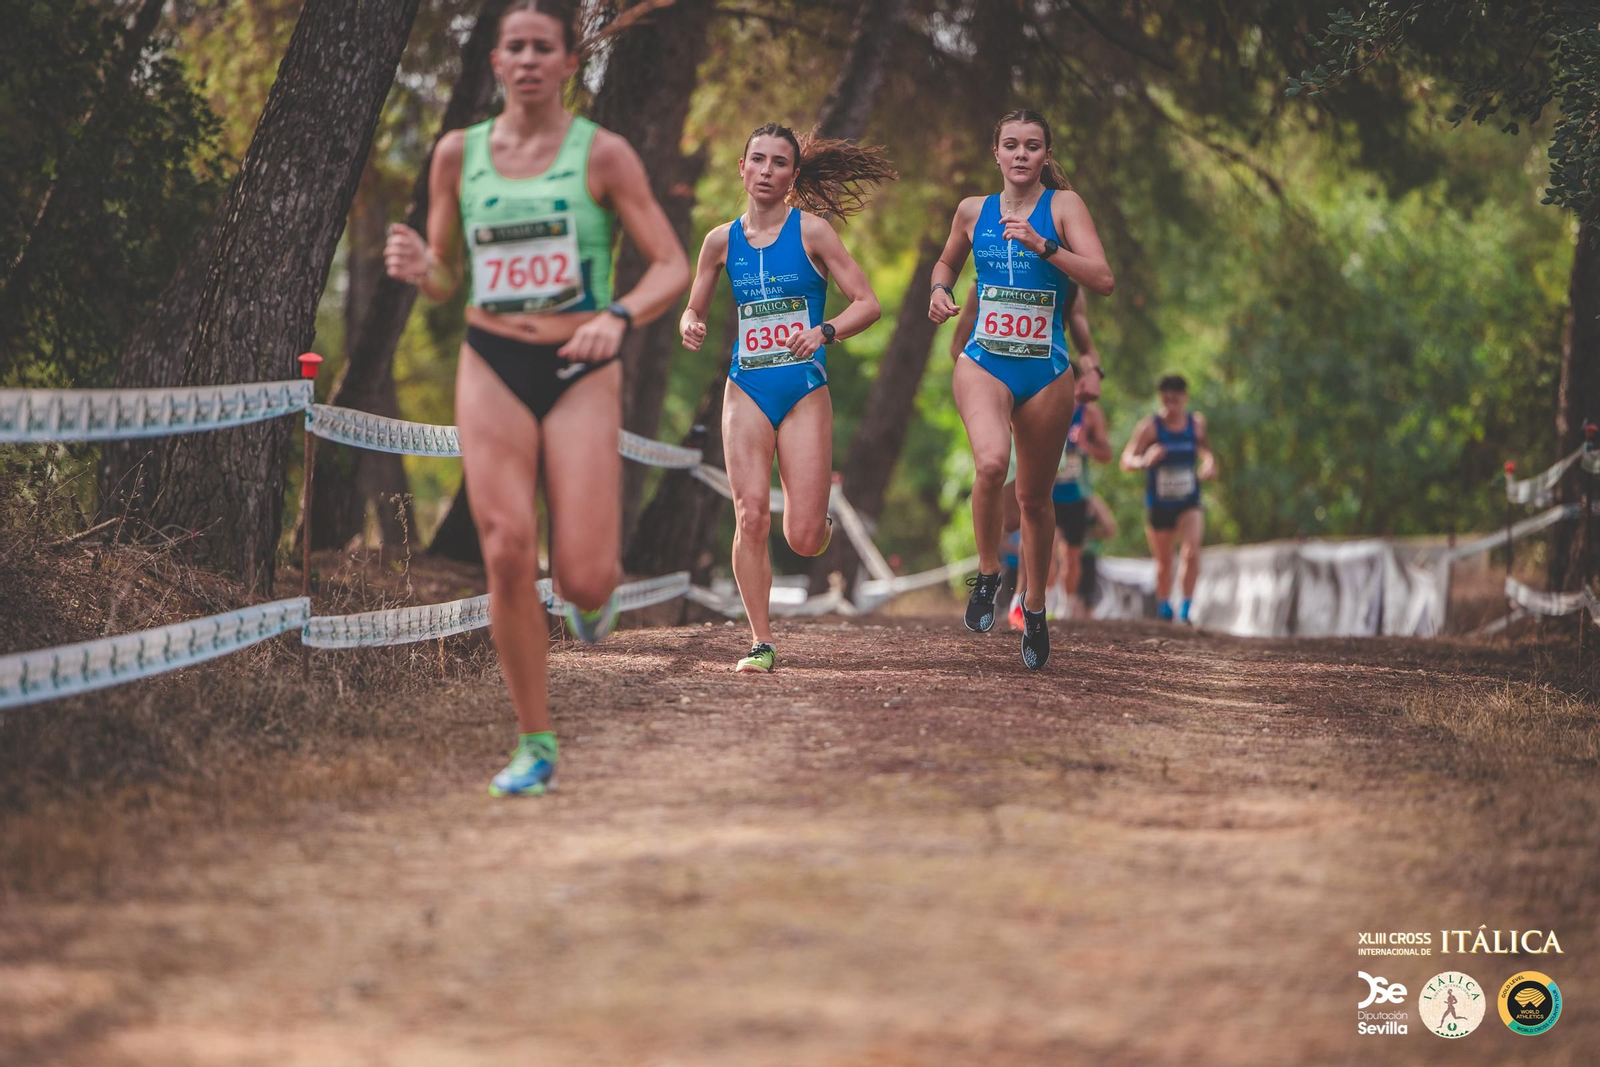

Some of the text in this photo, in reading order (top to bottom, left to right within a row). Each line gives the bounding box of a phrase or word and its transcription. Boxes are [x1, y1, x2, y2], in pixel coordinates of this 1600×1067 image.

[977, 250, 1040, 259] CORREDRE
[486, 252, 571, 291] 7602
[985, 312, 1047, 339] 6302
